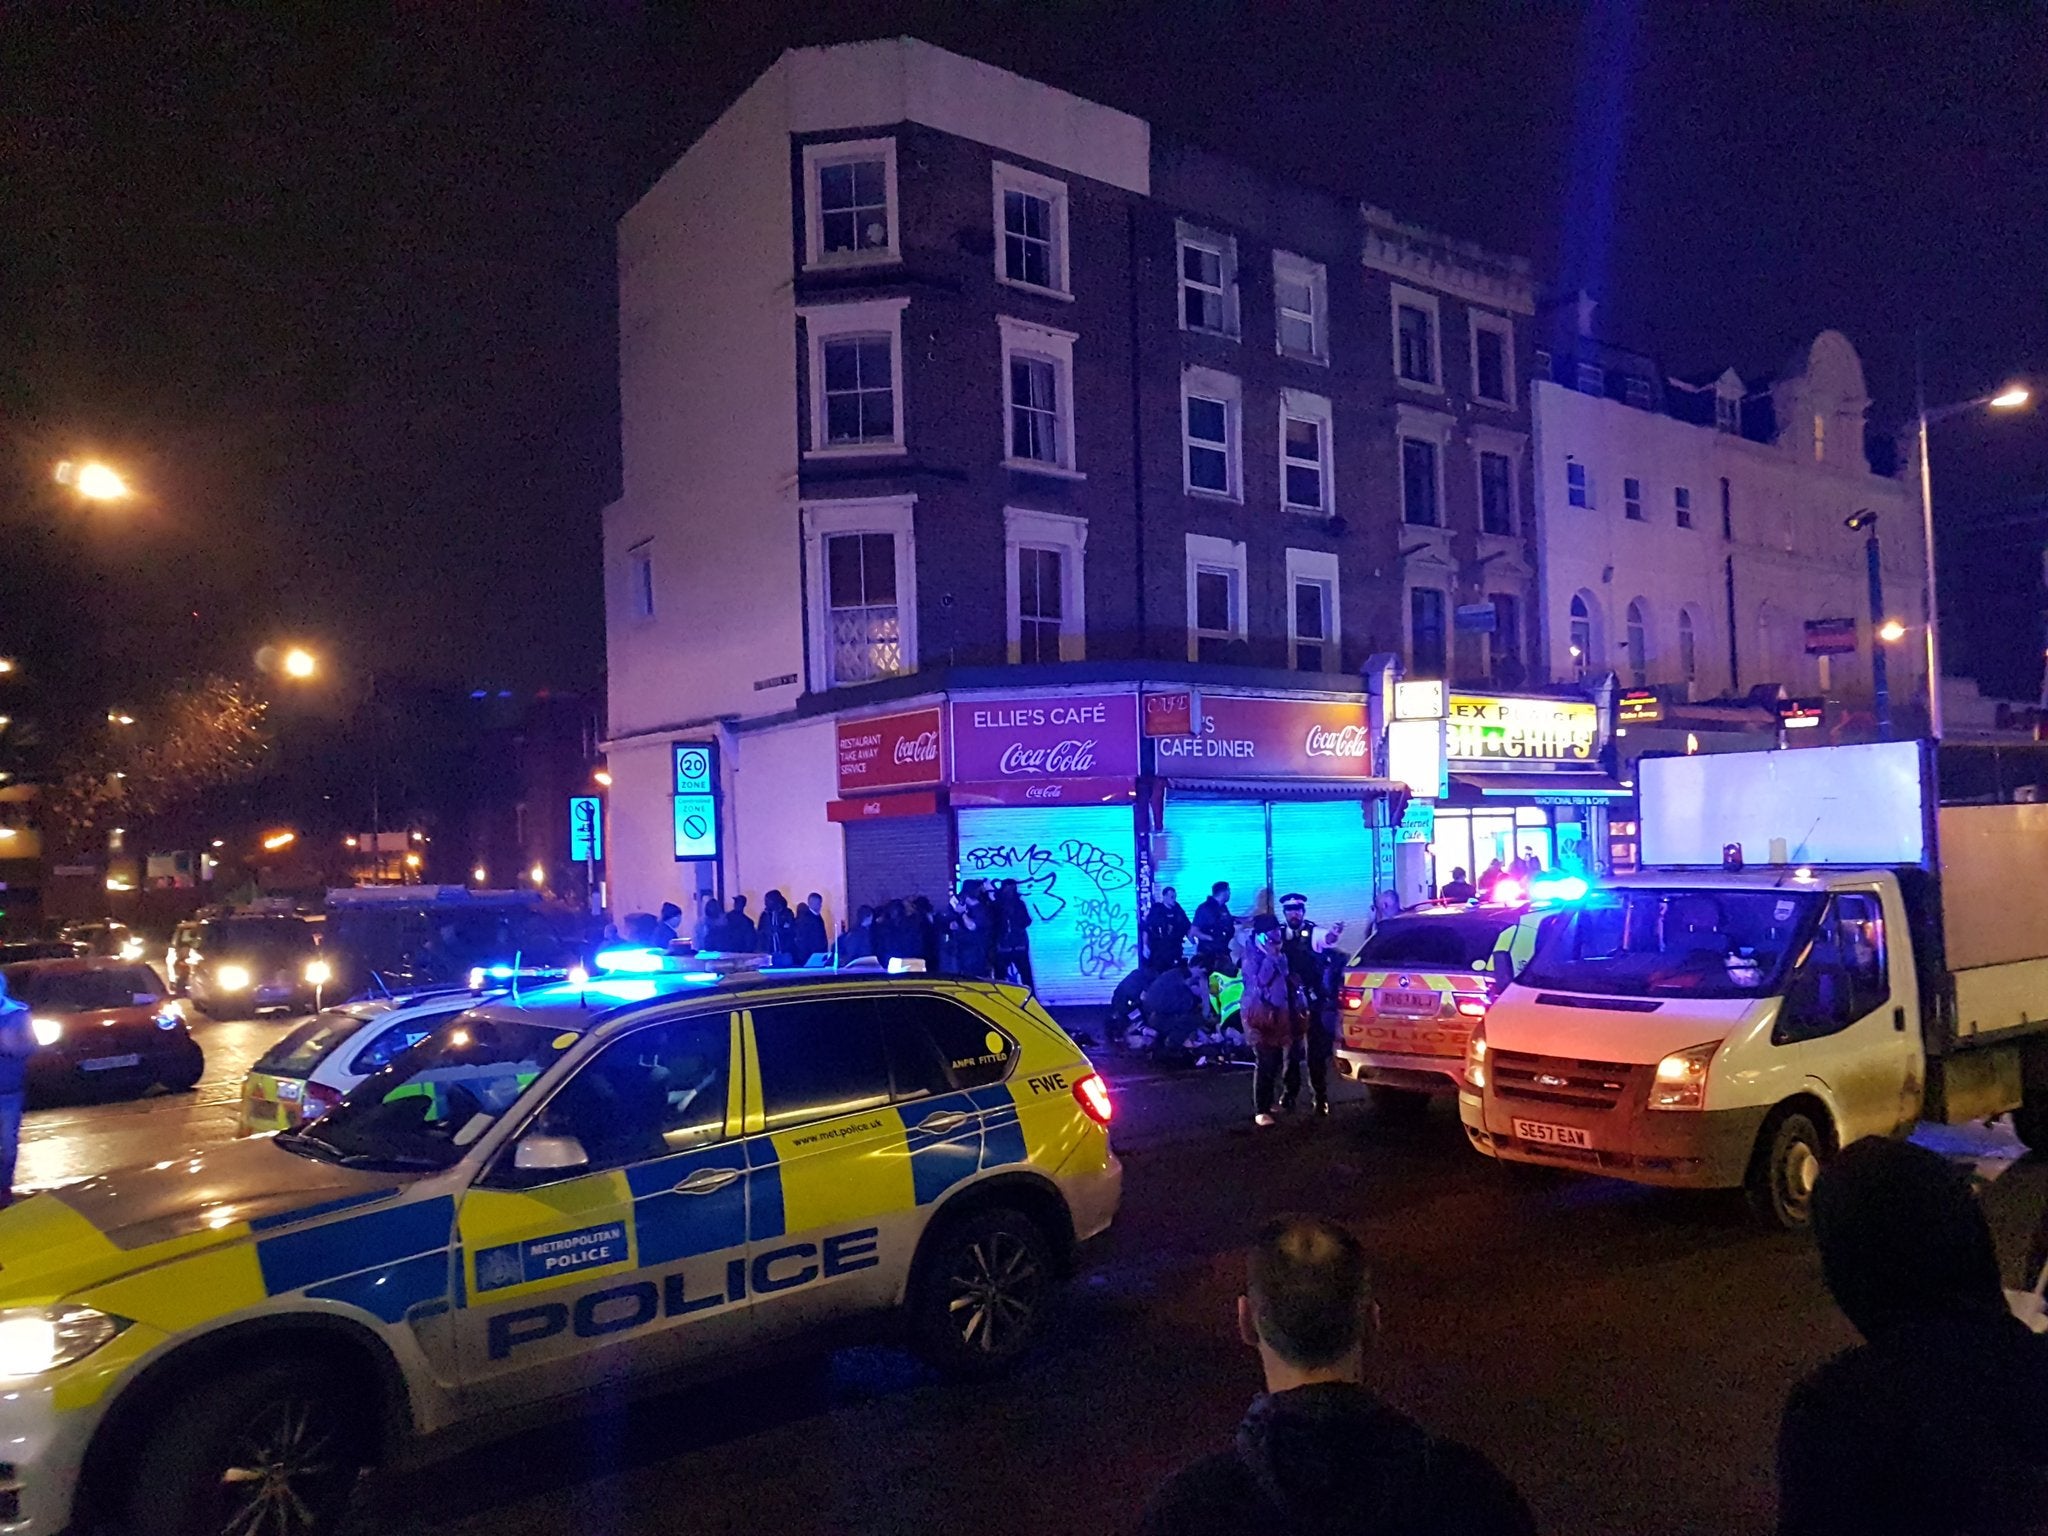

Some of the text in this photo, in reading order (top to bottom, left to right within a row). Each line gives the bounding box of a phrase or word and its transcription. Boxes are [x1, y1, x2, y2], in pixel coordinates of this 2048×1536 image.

[974, 702, 1107, 728] ELLIE'S CAFÉ
[840, 734, 882, 750] RESTAURANT
[1159, 735, 1255, 758] CAFÉ DINER
[1504, 726, 1592, 759] CHIPS
[840, 748, 879, 762] TAKE AWAY
[684, 759, 703, 771] 20
[840, 762, 867, 775] SERVICE
[681, 781, 706, 789] ZONE
[683, 805, 706, 813] ZONE
[1401, 819, 1430, 828] nternet
[1349, 1025, 1471, 1044] POLICE
[951, 1052, 1008, 1070] ANPR FITTED
[1027, 1072, 1069, 1095] FWE
[792, 1117, 884, 1147] www.met.police.uk
[1519, 1122, 1553, 1140] SE57
[529, 1227, 621, 1257] METROPOLITAN
[544, 1244, 611, 1271] POLICE
[487, 1226, 880, 1362] POLICE
